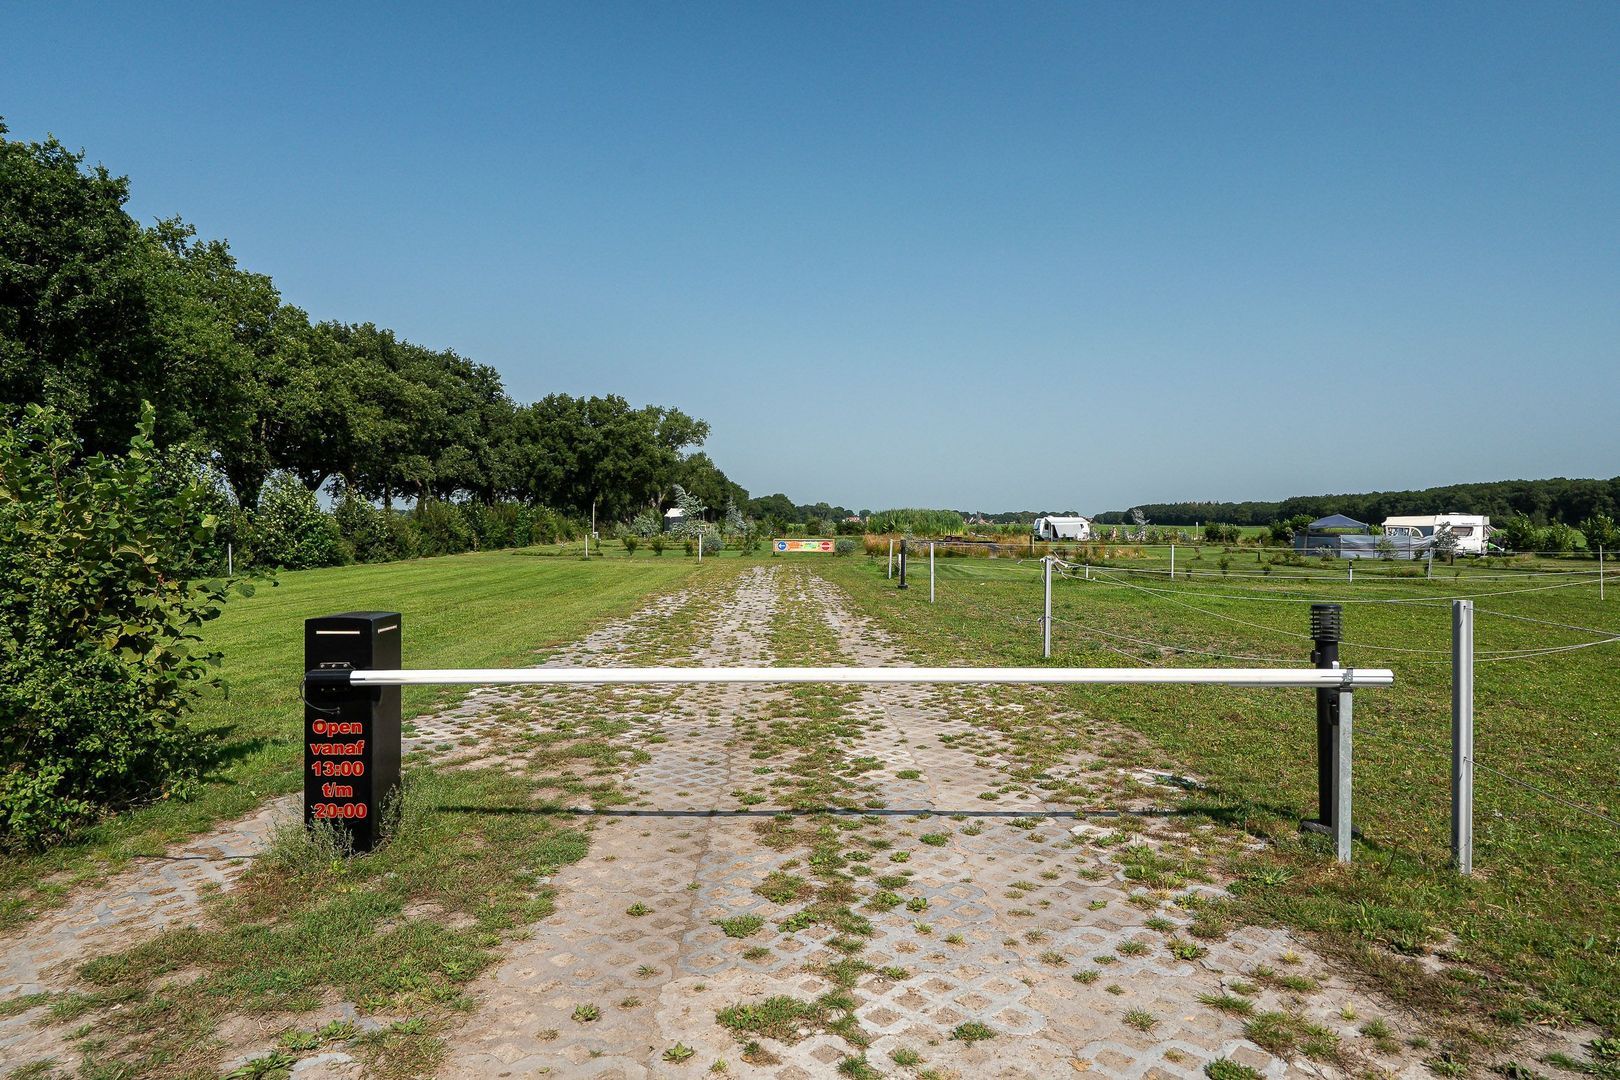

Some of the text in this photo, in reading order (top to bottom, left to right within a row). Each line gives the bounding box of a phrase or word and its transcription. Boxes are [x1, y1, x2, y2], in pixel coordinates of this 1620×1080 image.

[312, 719, 363, 737] Open
[310, 740, 365, 756] vanaf
[312, 761, 364, 776] 13:00
[322, 782, 353, 798] t/m
[314, 803, 367, 819] 20:00
